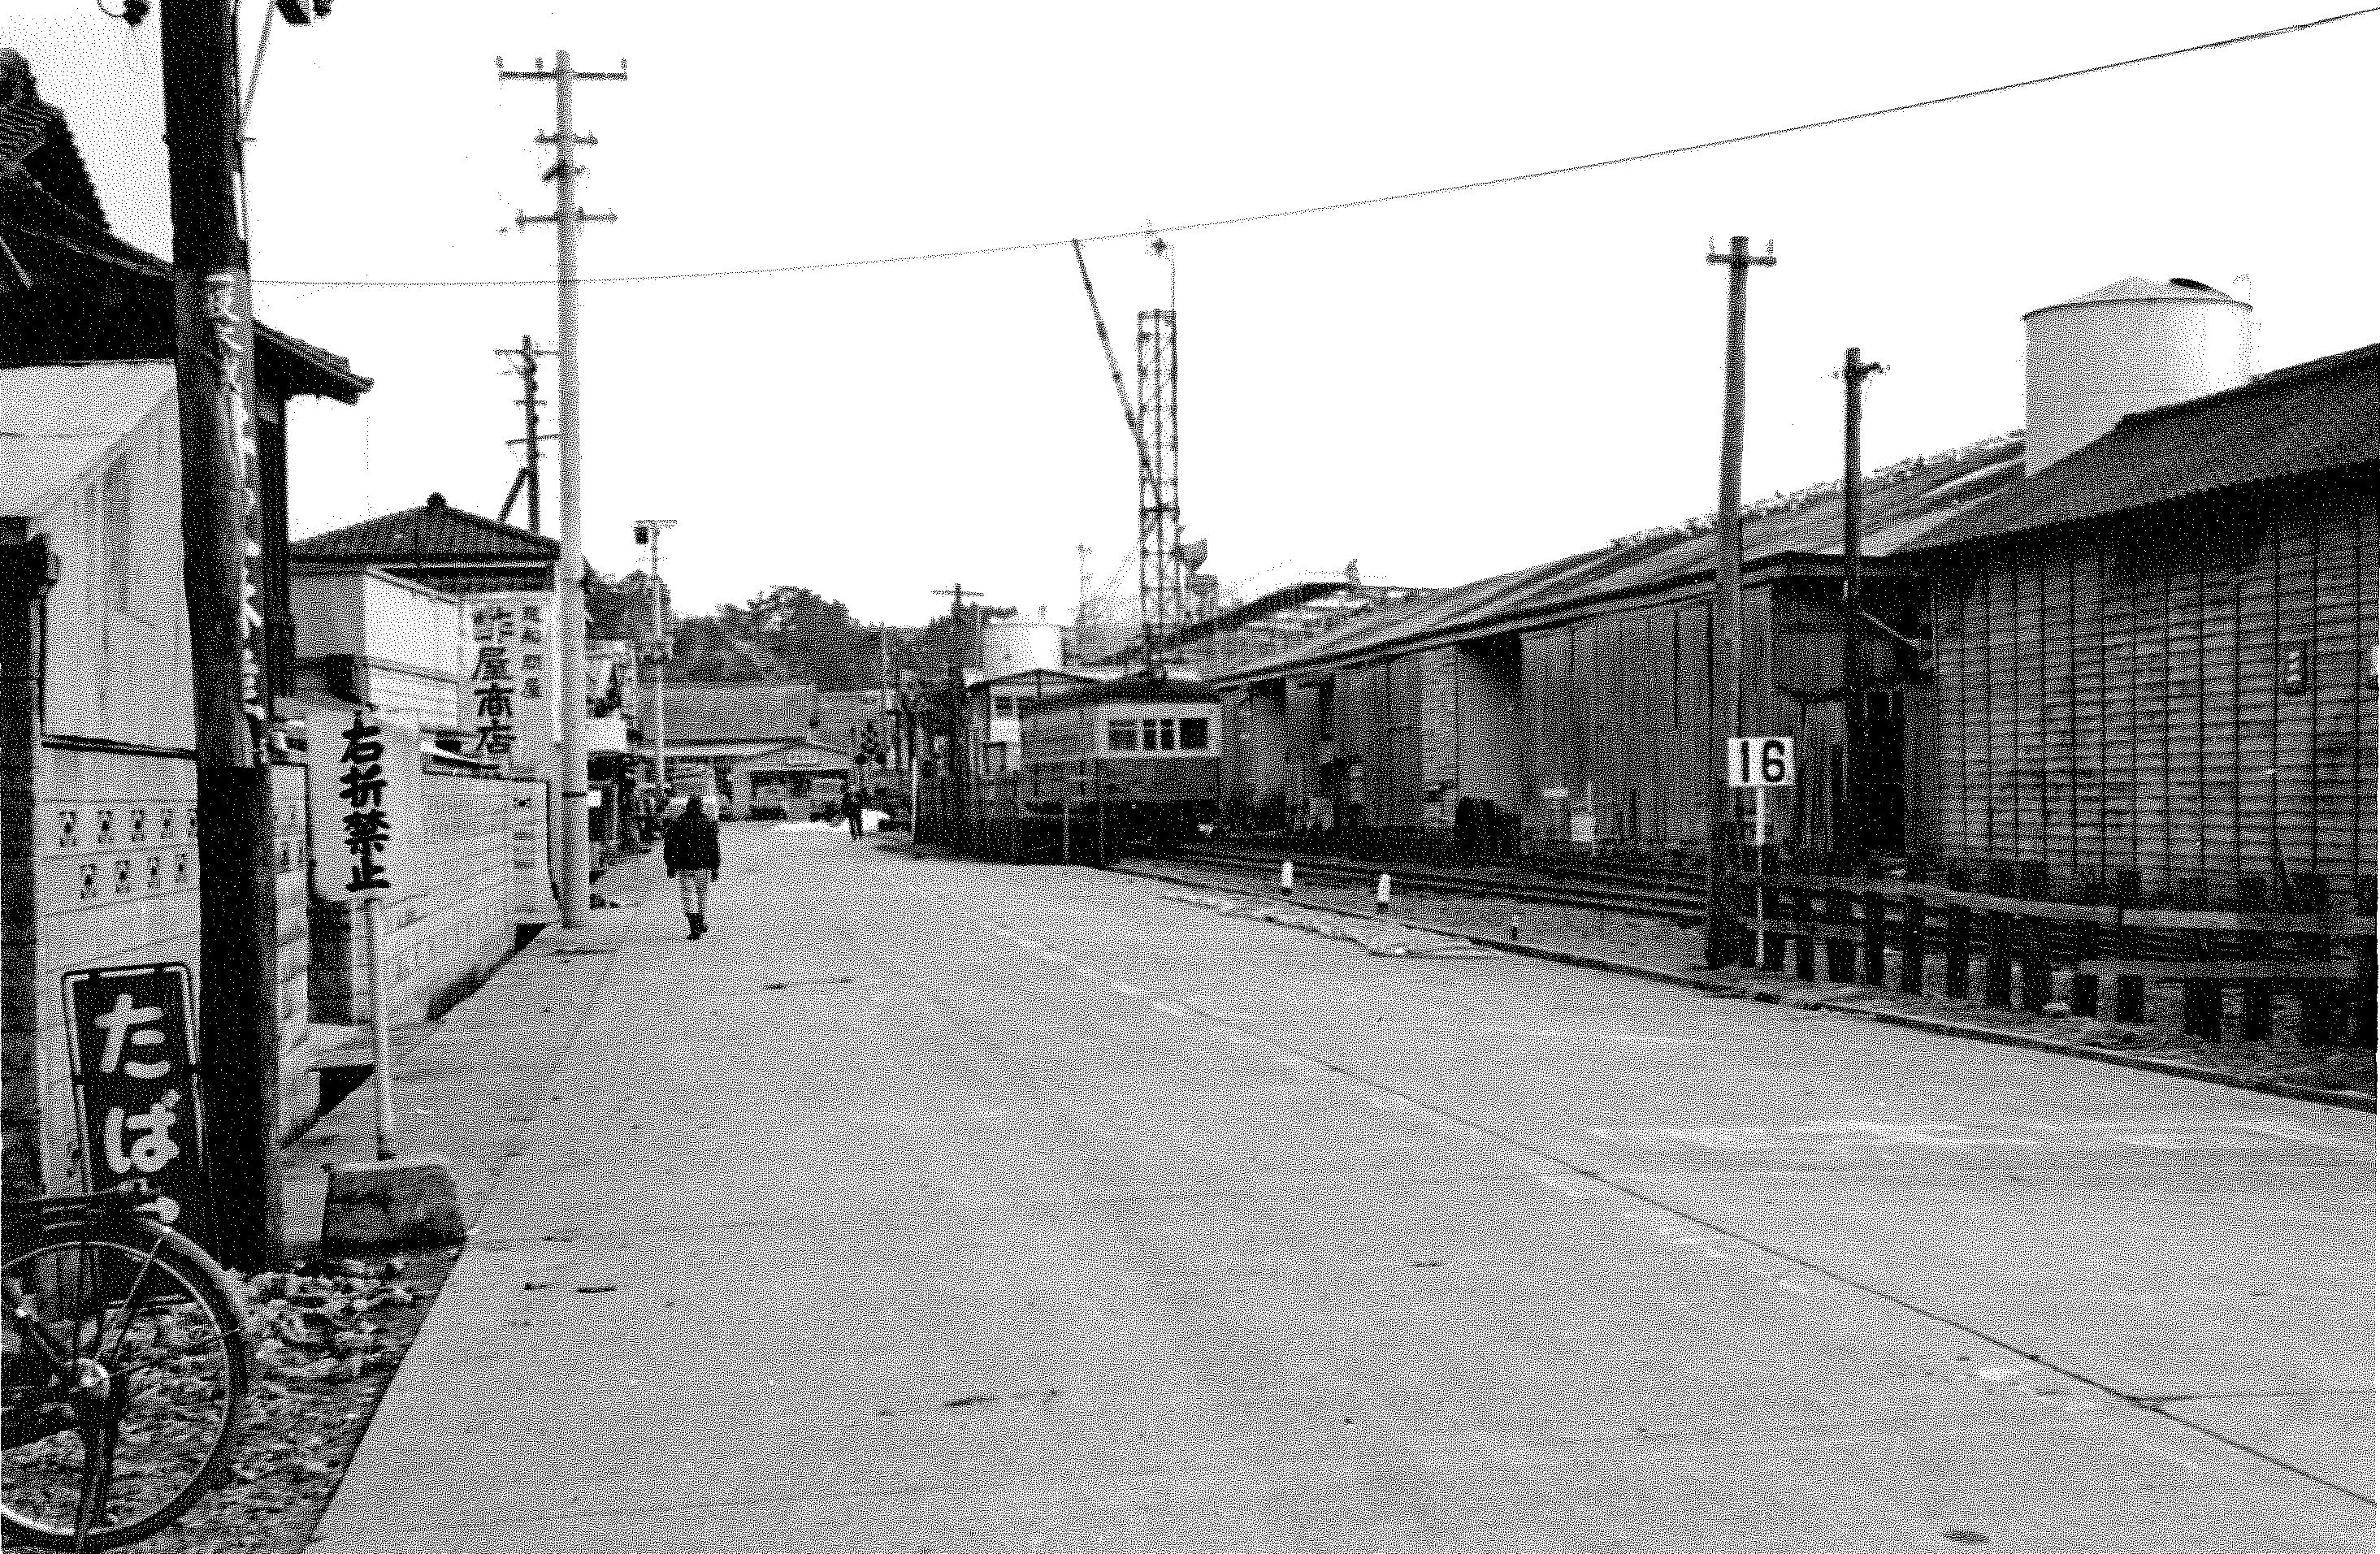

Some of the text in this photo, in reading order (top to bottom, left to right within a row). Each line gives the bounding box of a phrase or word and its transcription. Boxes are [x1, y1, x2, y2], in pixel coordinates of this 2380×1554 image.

[339, 711, 391, 892] 右折禁止
[1741, 741, 1785, 783] 16
